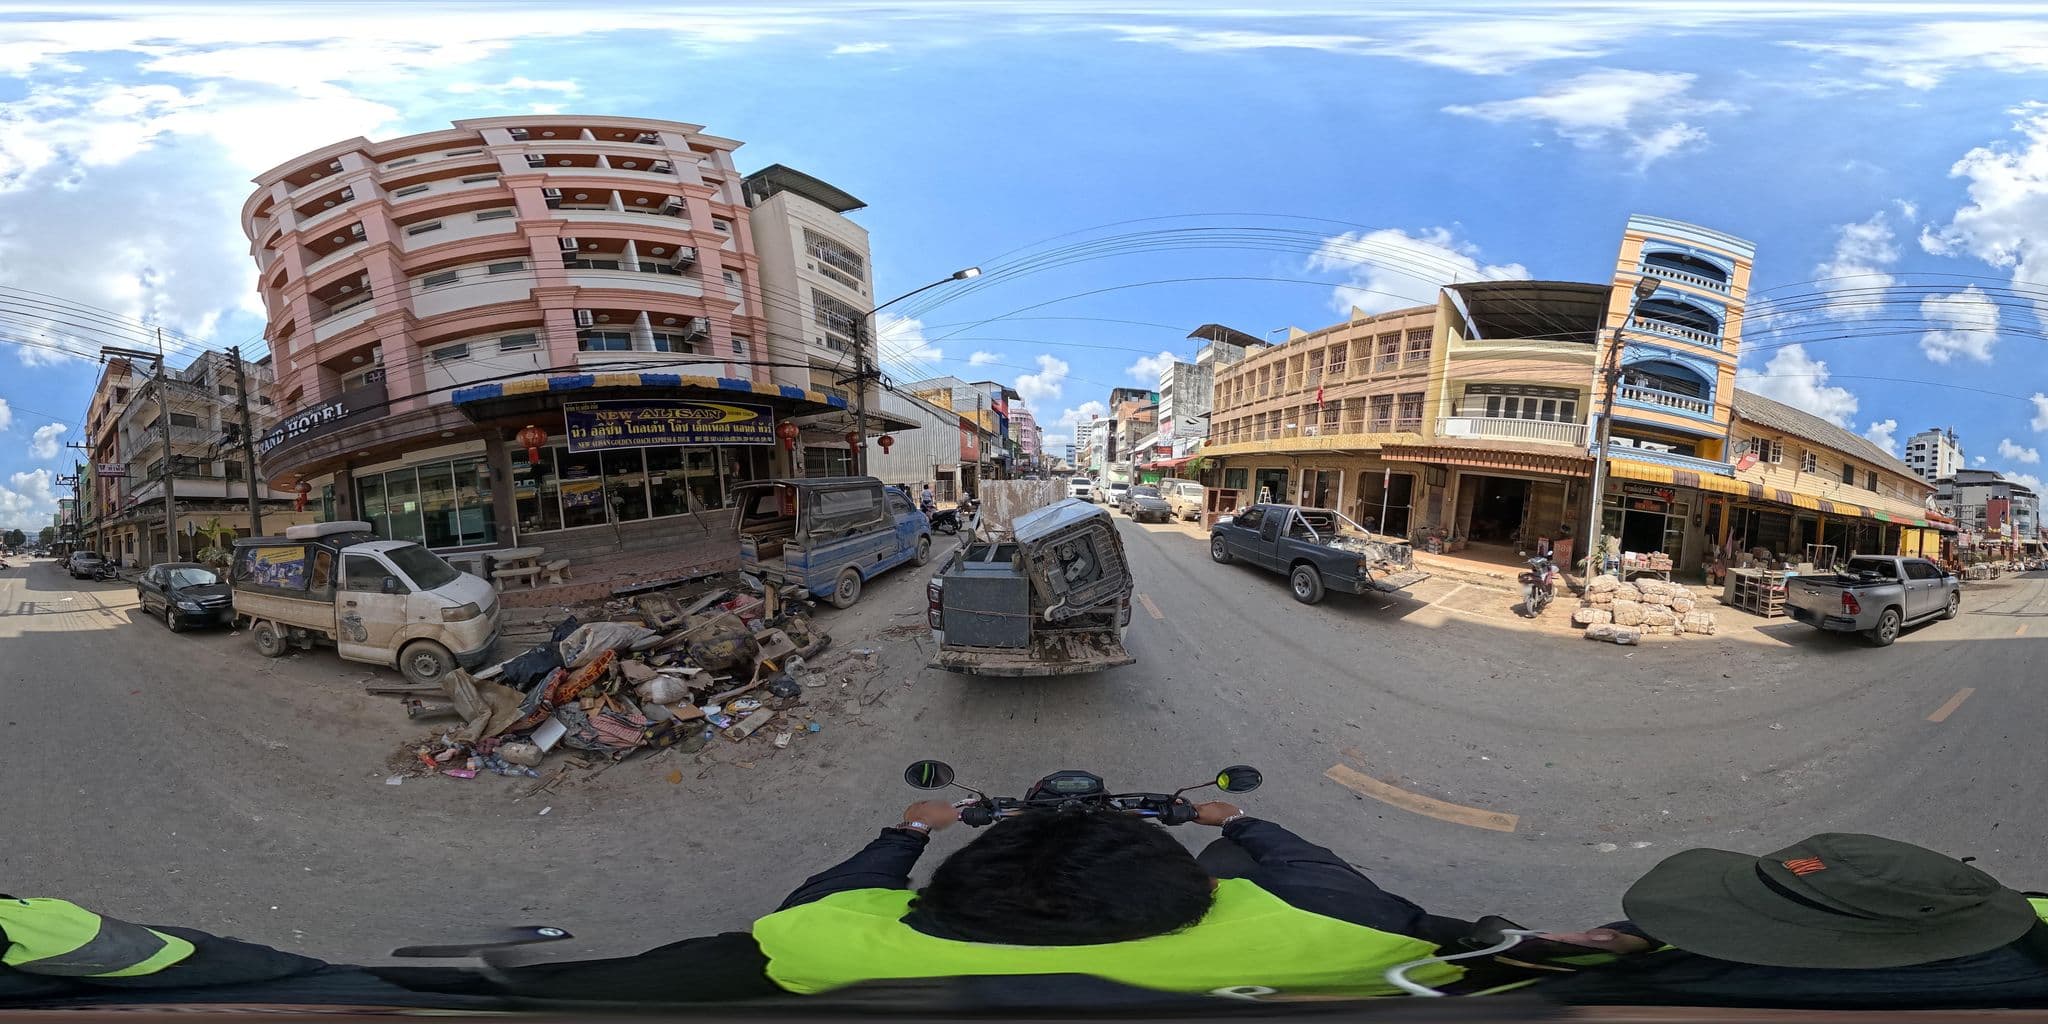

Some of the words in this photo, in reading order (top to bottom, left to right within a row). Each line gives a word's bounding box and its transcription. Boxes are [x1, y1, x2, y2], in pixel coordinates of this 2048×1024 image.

[595, 410, 633, 421] NEW
[638, 407, 721, 420] ALISAN
[258, 429, 285, 455] RAND
[288, 402, 349, 438] HOTEL
[571, 424, 587, 438] นิว
[577, 441, 591, 449] NEW
